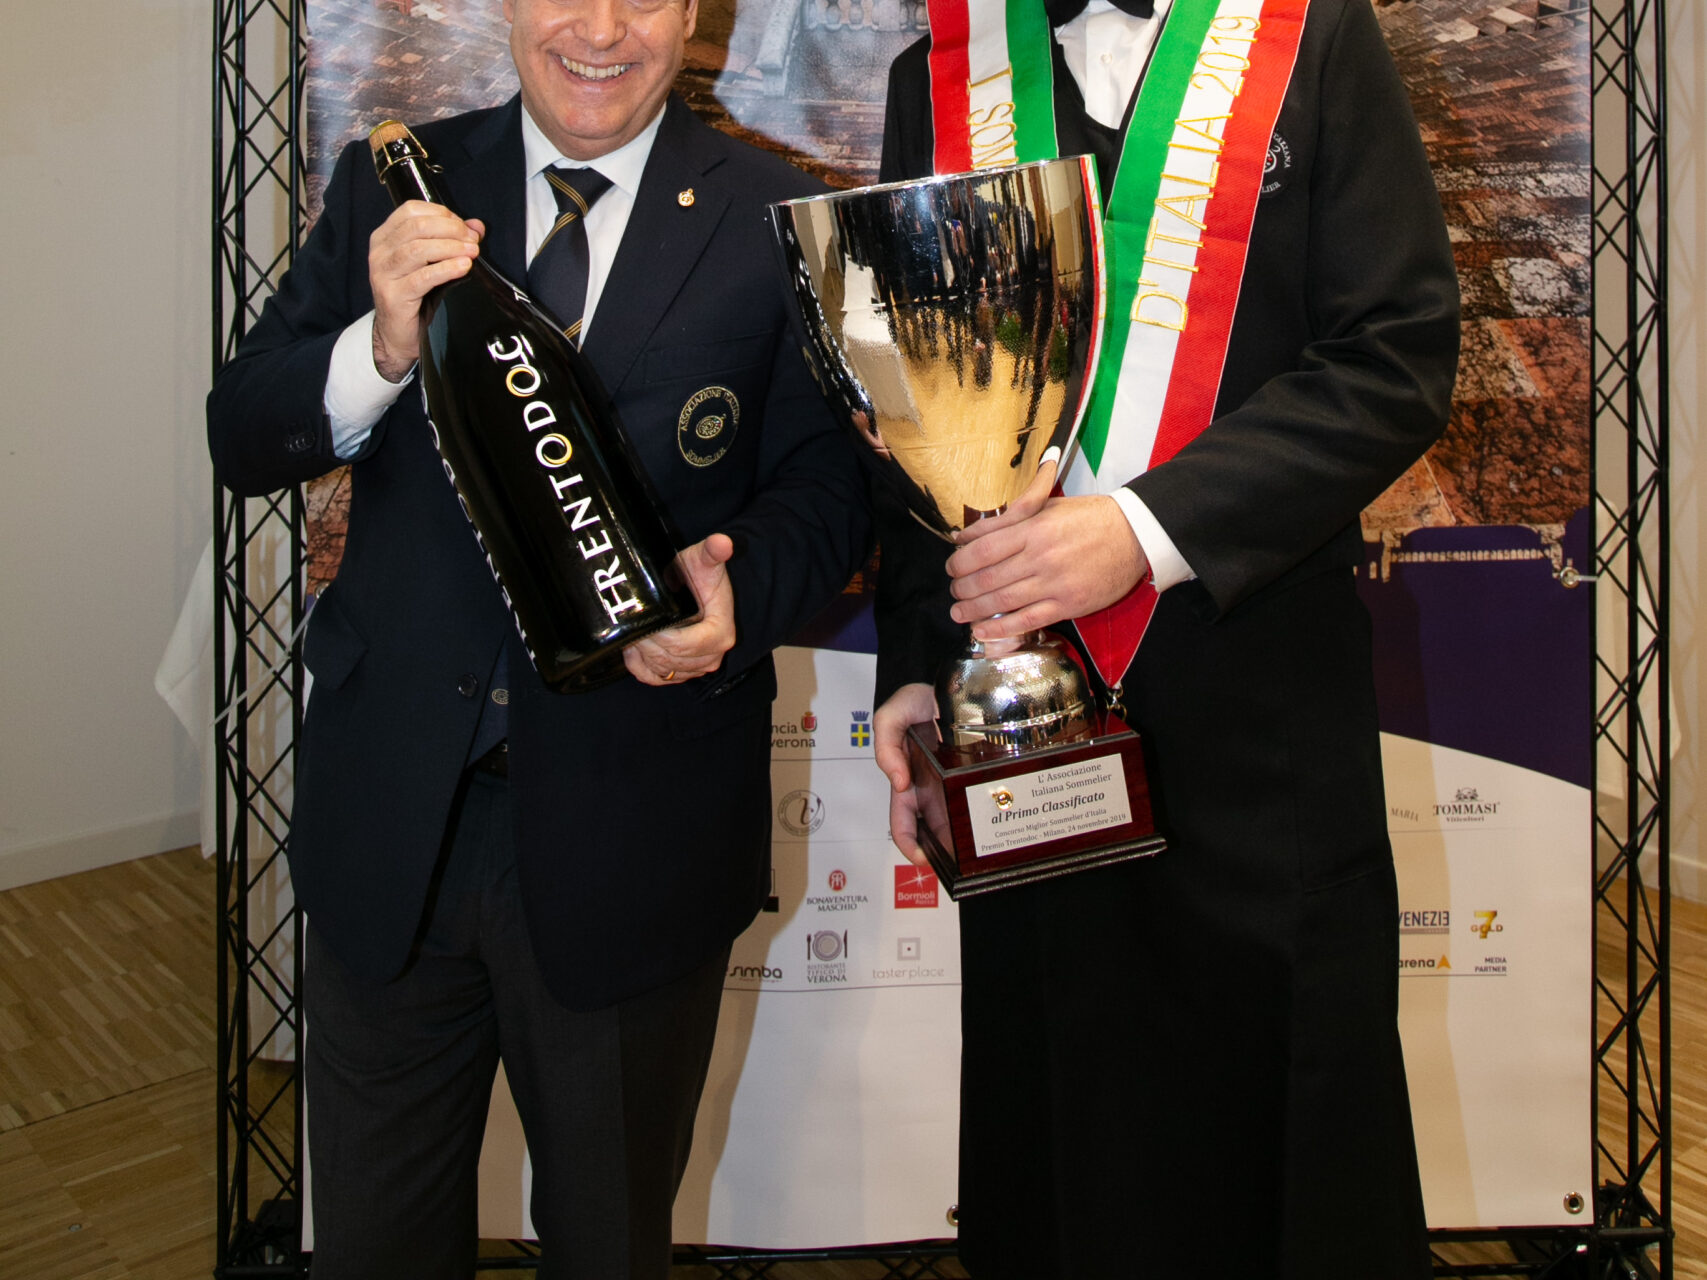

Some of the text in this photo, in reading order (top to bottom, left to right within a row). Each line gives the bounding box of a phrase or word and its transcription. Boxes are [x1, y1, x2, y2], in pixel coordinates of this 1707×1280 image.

[1189, 15, 1261, 97] 2019
[487, 331, 645, 625] TRENTODOC
[1047, 763, 1101, 782] Associazione
[1031, 773, 1112, 798] Italiana Sommelier
[991, 792, 1105, 825] al Primo Classificato
[1433, 803, 1498, 816] TOMMASI
[981, 841, 1005, 852] Premio
[1006, 833, 1039, 847] Trentodoc
[1067, 824, 1076, 833] 24
[1077, 819, 1109, 831] novembre
[1110, 813, 1126, 824] 2019
[994, 826, 1025, 838] Concorso
[1026, 820, 1049, 833] Miglior
[1050, 813, 1083, 826] Sommelier
[806, 895, 868, 906] BONAVENTURA
[817, 903, 858, 912] MASCHIO
[807, 974, 848, 984] VERONA
